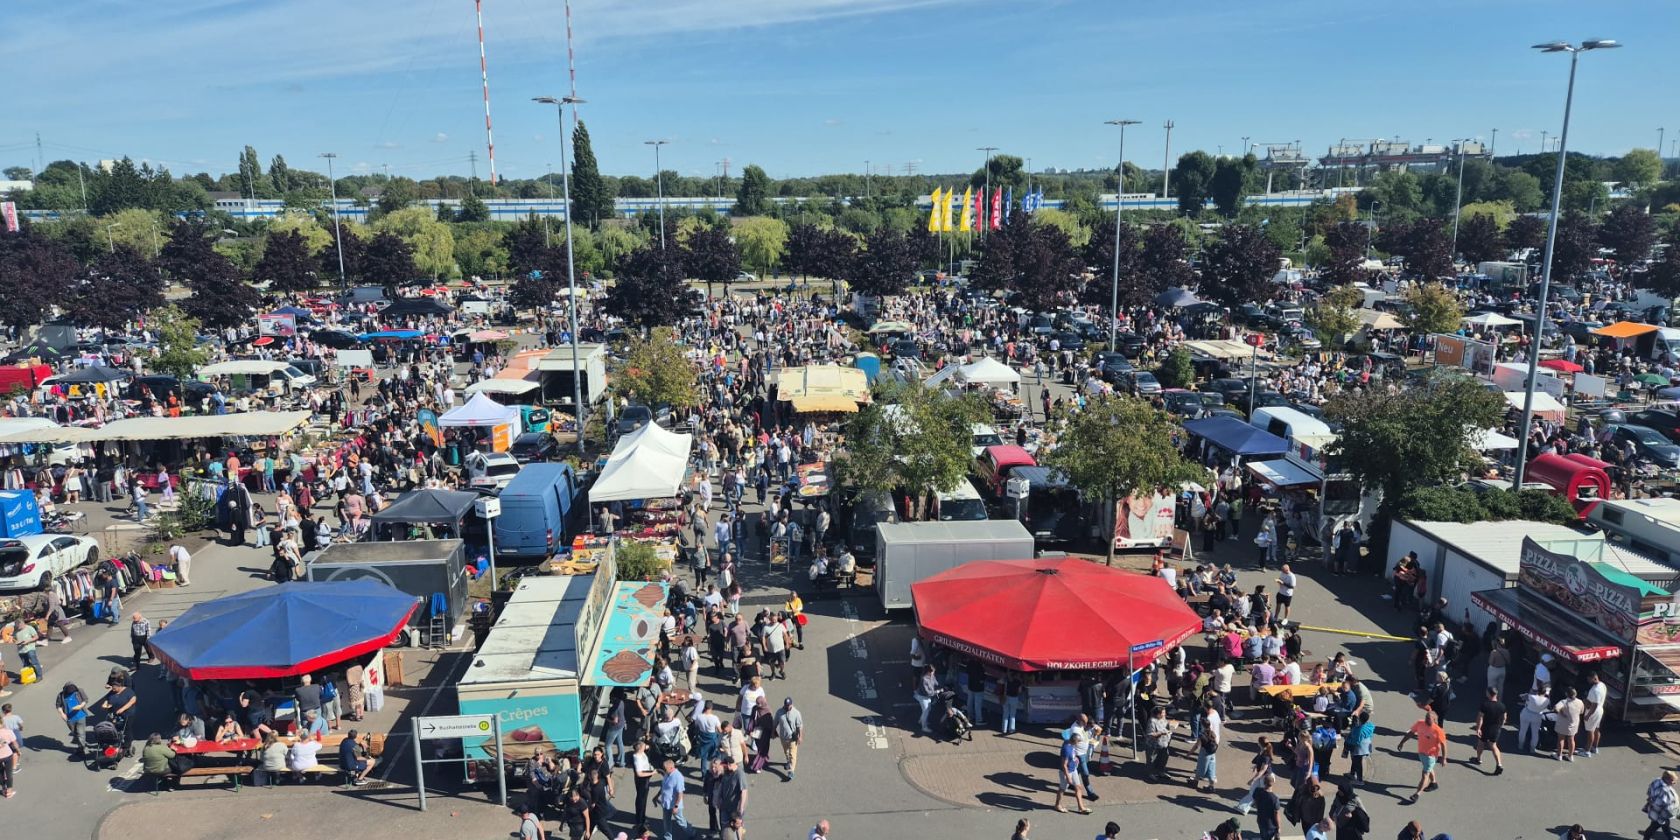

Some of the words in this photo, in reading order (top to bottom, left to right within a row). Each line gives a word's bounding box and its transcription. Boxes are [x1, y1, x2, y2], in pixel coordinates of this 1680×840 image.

[1438, 342, 1454, 354] Neu
[1525, 550, 1559, 576] PIZZA
[1595, 583, 1633, 613] PIZZA
[934, 634, 1006, 664] GRILLSPEZIALITÄTEN
[1518, 624, 1534, 639] PIZZA
[1535, 635, 1549, 648] BAR
[1550, 644, 1571, 660] ITALIA
[1046, 659, 1120, 670] HOLZKOHLEGRILL
[1577, 651, 1600, 661] PIZZA
[500, 705, 549, 722] Crêpes
